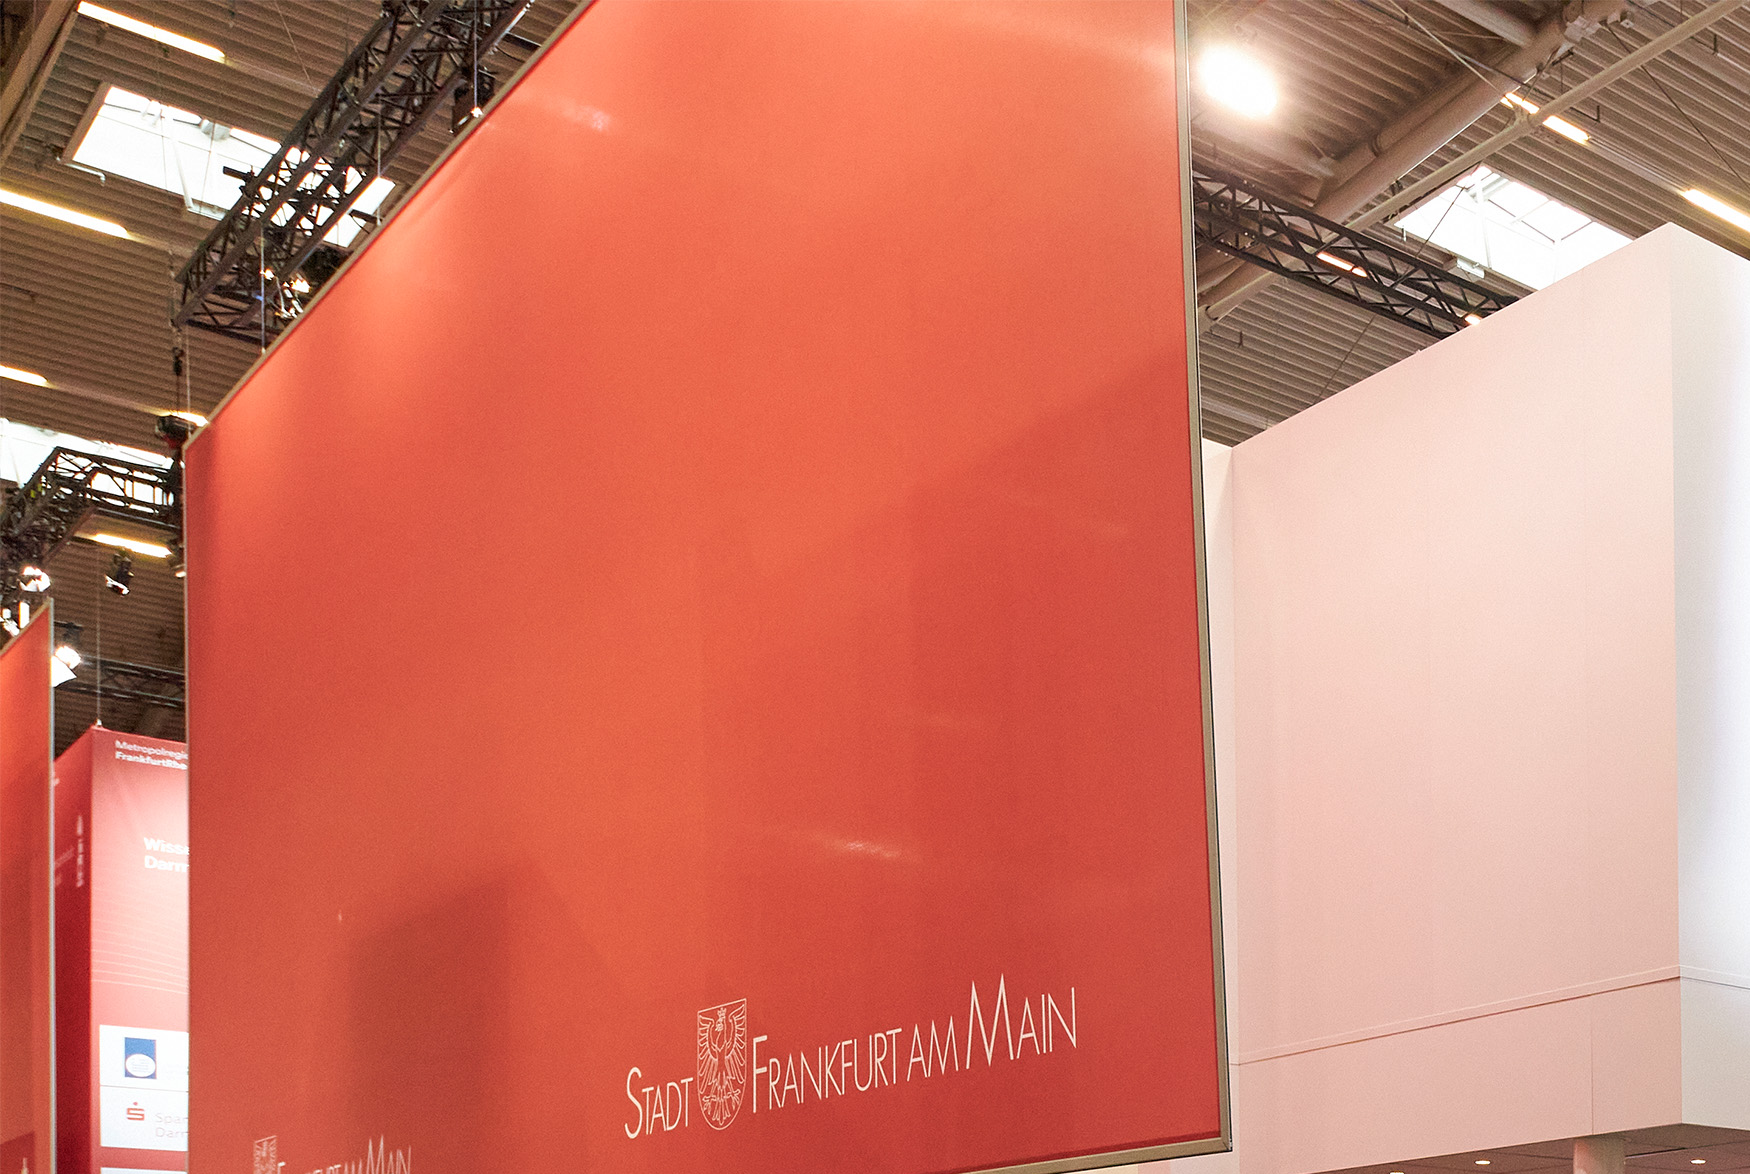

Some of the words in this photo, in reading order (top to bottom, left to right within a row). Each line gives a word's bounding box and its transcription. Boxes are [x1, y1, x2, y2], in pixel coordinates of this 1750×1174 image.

[625, 1067, 693, 1138] STADT
[753, 1029, 902, 1113] FRANKFURT
[907, 1016, 958, 1081] AM
[966, 973, 1077, 1069] MAIN
